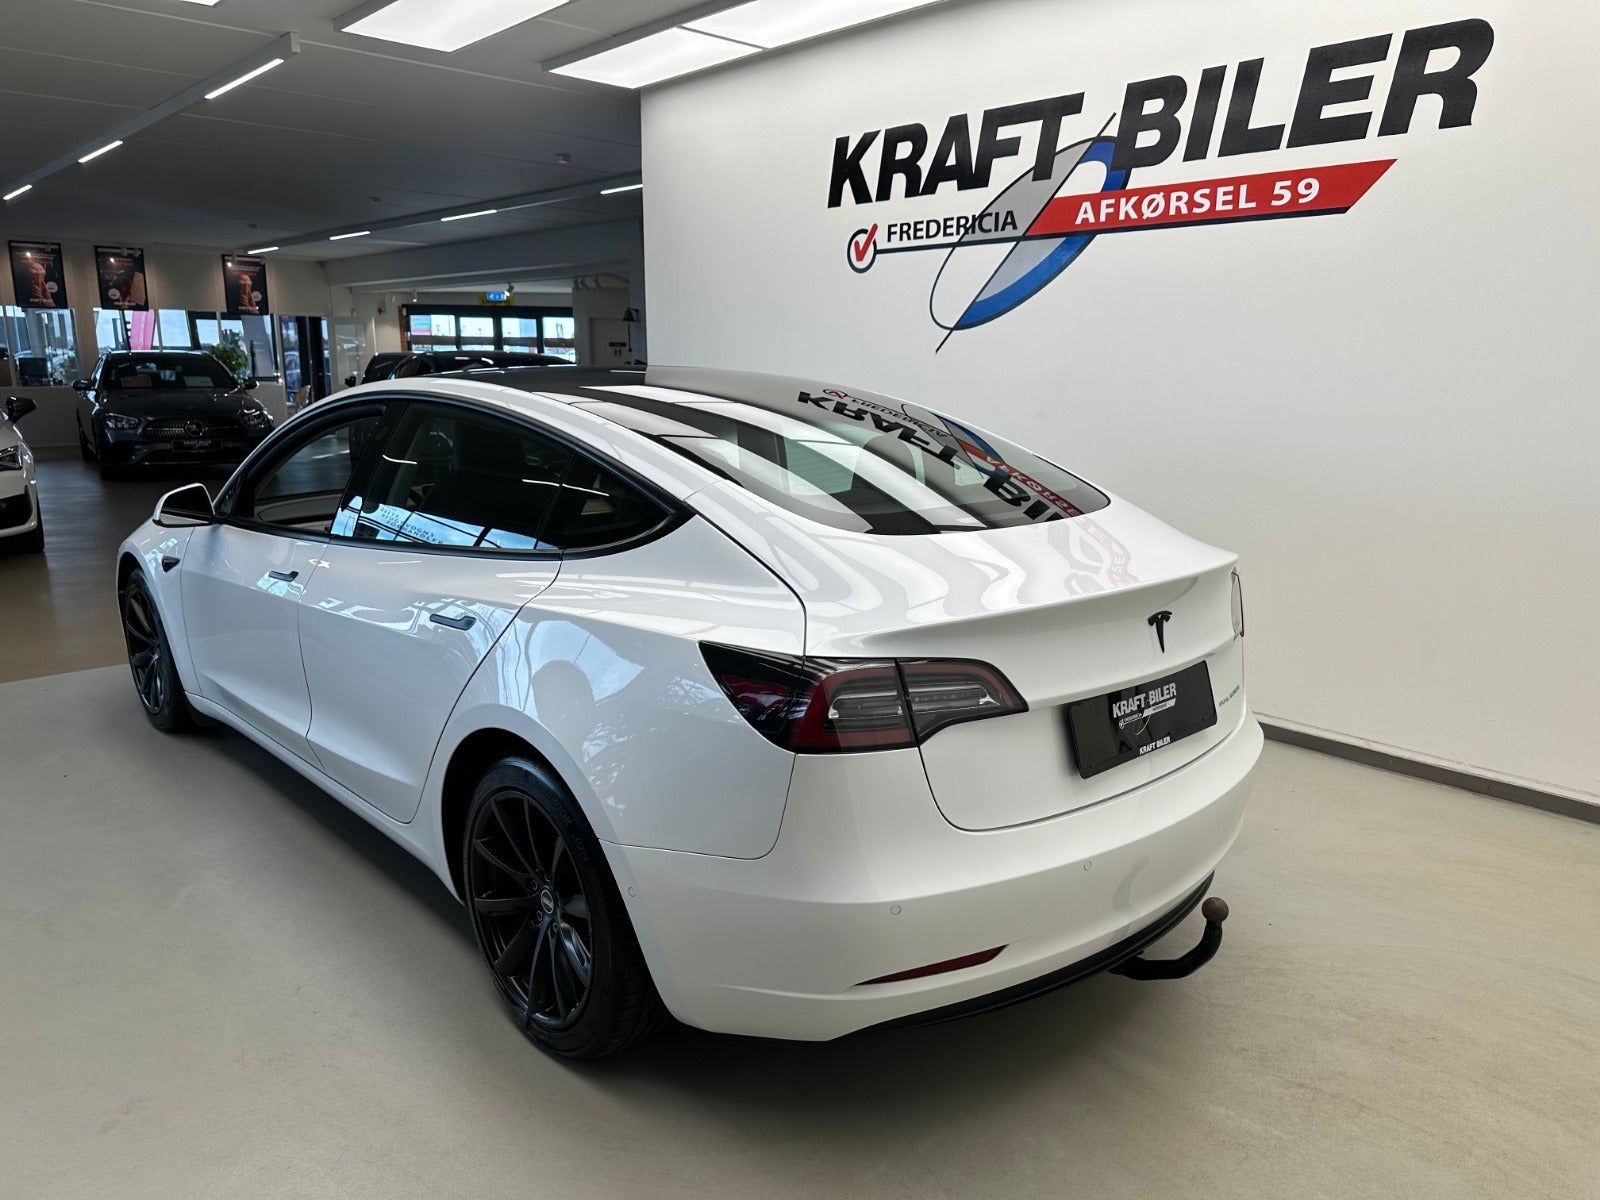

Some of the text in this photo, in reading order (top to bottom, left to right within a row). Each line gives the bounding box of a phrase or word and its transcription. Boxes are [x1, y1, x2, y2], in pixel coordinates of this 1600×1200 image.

[827, 18, 1495, 208] KRAFT BILER
[1074, 178, 1320, 225] AFKØRSEL 59
[886, 210, 1018, 243] FREDERICIA
[1112, 693, 1146, 718] KRAFT
[1148, 683, 1177, 705] BILER
[1139, 736, 1171, 755] KRAFT BILER
